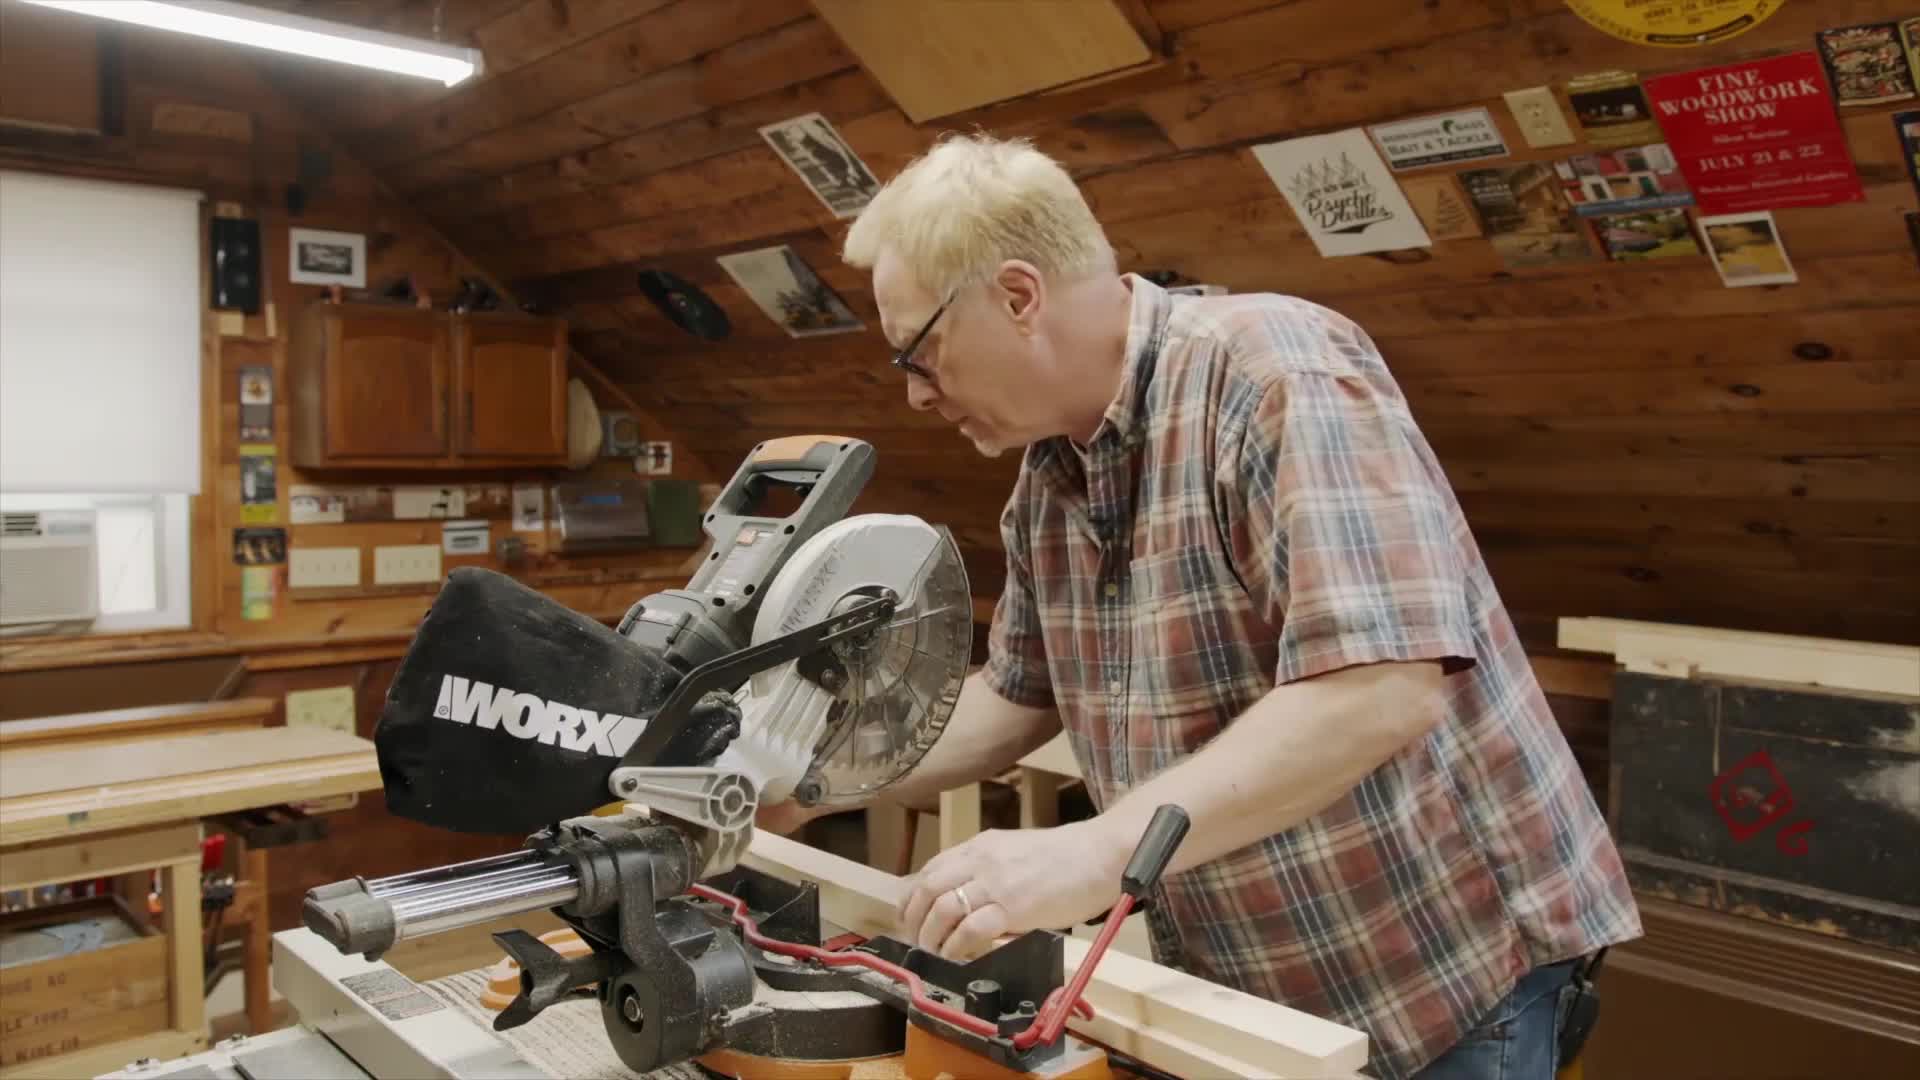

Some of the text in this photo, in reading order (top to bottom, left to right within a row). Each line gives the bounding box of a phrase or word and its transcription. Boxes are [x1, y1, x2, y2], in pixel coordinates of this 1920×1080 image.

[1698, 69, 1763, 92] FINE
[1659, 78, 1820, 117] WOODWORK
[1703, 101, 1777, 125] SHOW
[1436, 132, 1492, 148] TACKLE
[1699, 143, 1825, 173] JULY 21 & 22
[434, 674, 648, 758] WORX
